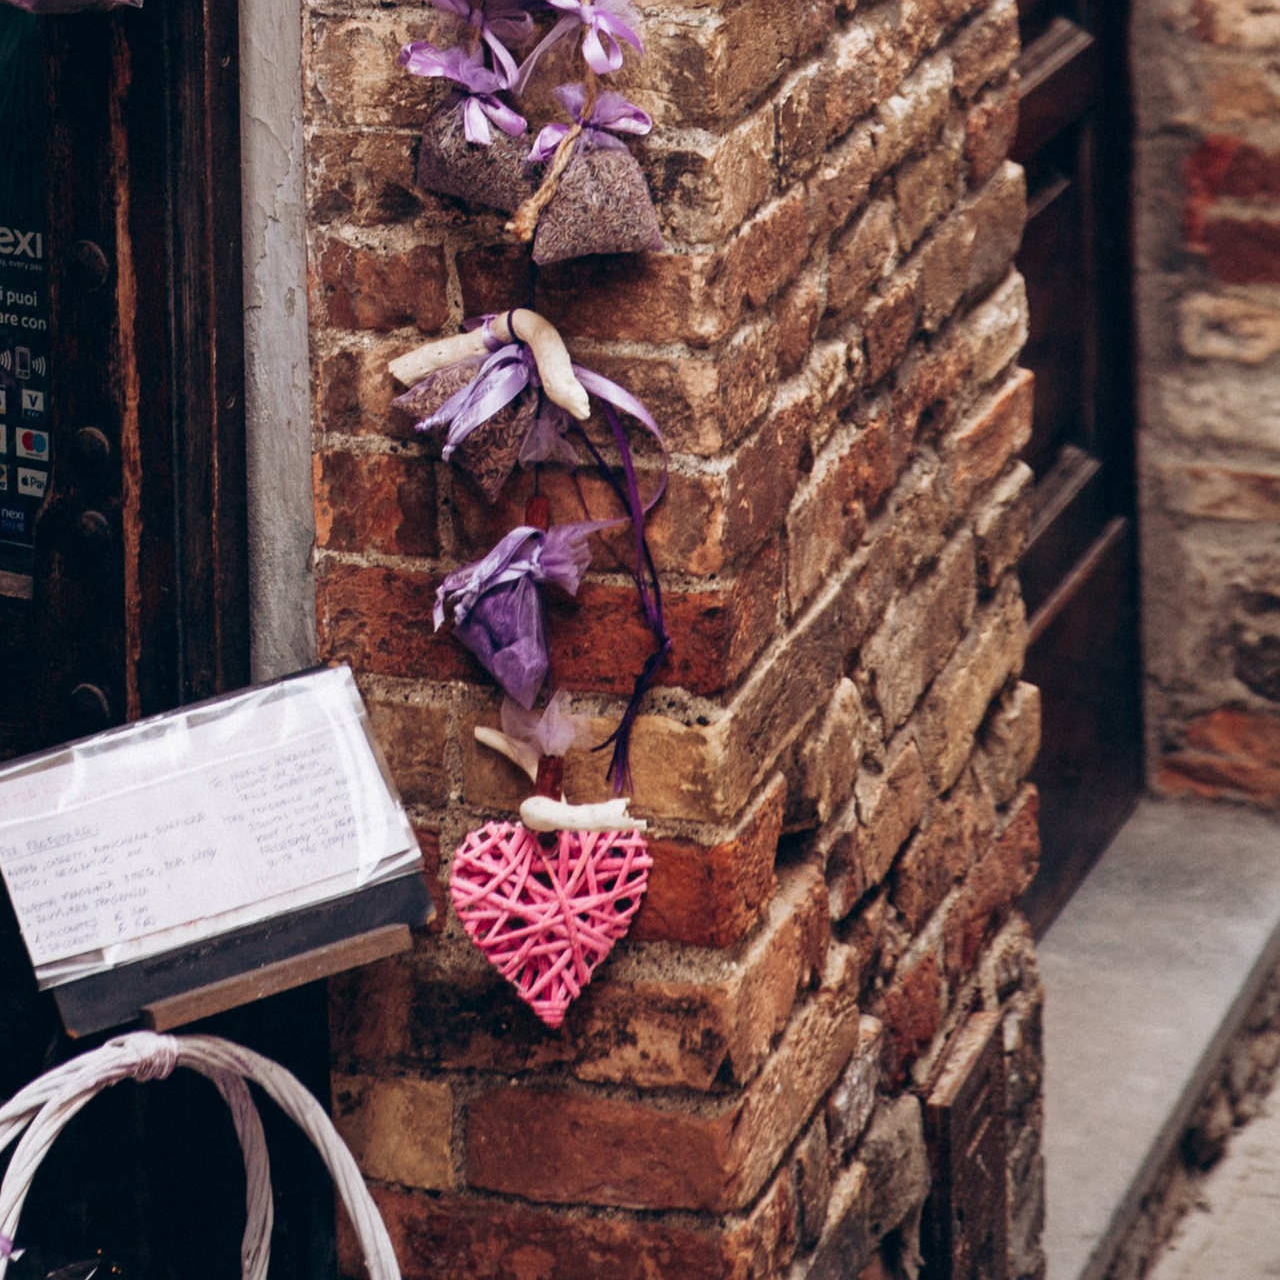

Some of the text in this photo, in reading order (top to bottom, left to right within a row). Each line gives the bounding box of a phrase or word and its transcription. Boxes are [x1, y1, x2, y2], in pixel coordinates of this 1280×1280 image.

[9, 260, 28, 271] every
[6, 290, 38, 307] puoi
[21, 316, 47, 331] con
